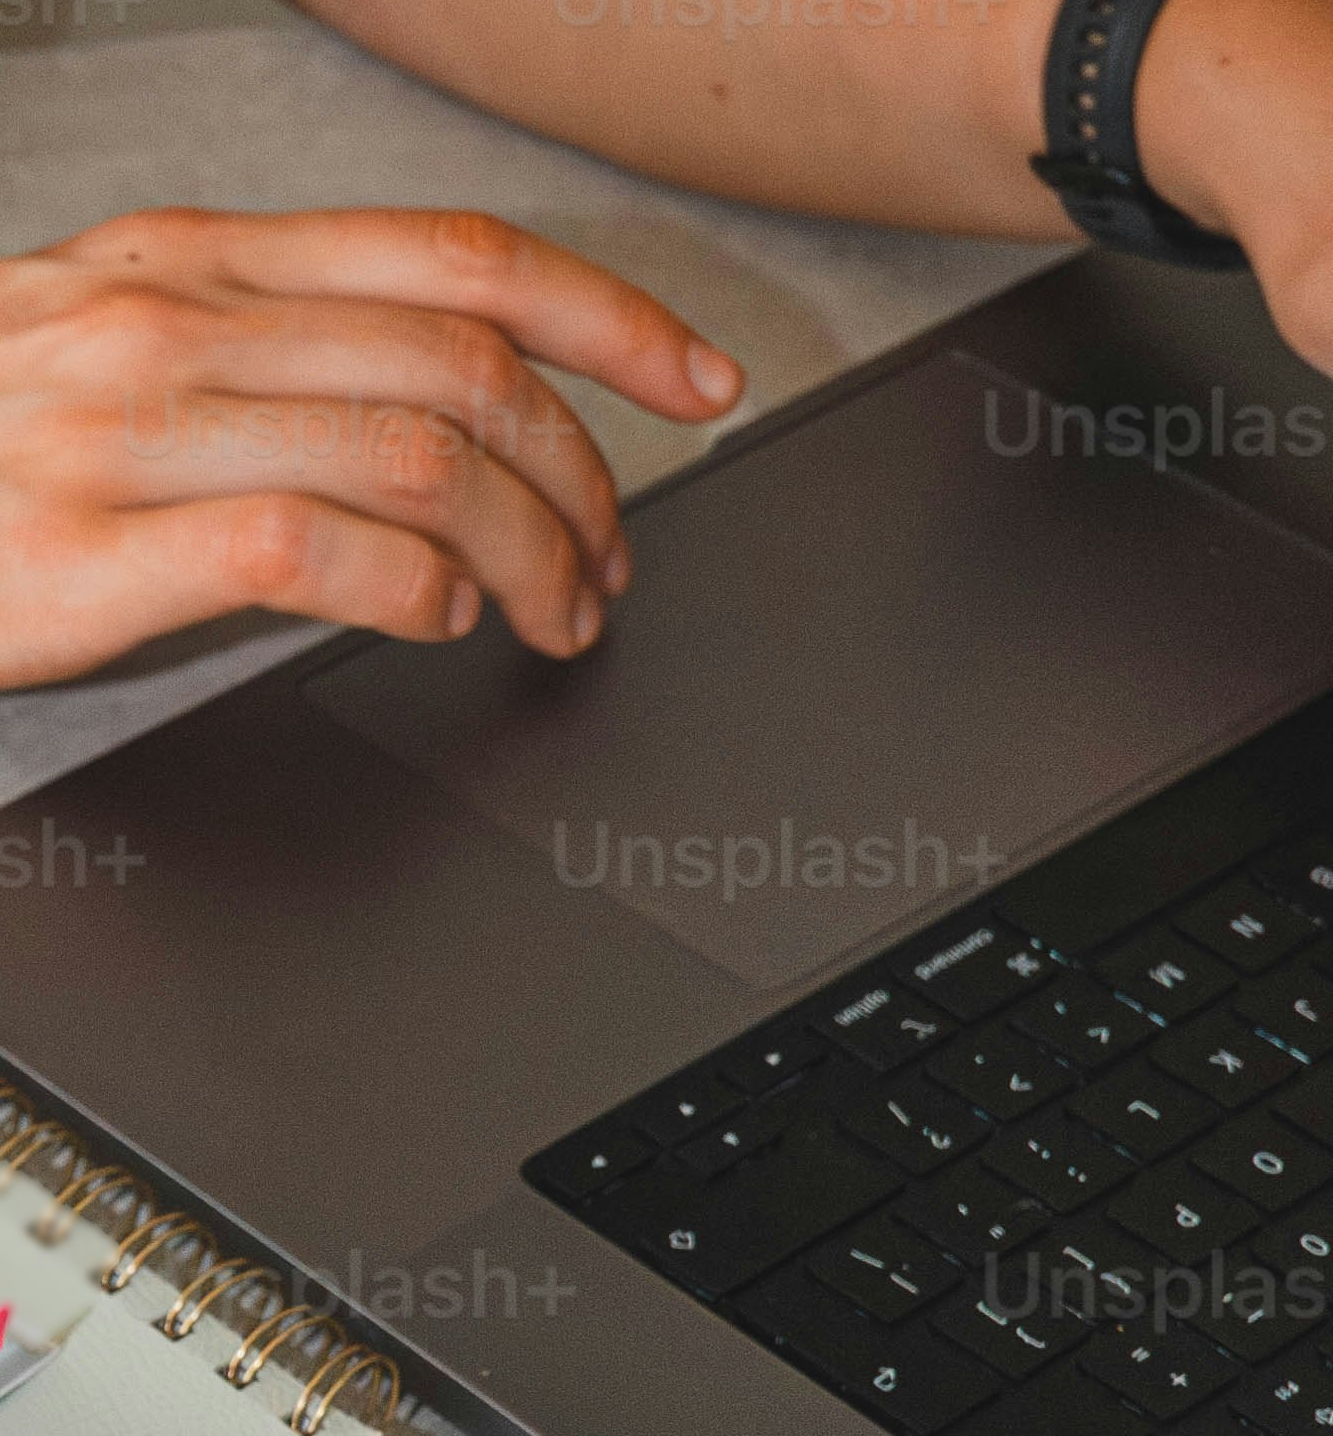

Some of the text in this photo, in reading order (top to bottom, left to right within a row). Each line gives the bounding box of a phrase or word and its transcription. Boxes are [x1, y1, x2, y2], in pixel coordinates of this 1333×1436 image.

[1231, 915, 1262, 938] N
[1151, 964, 1184, 988] M
[1209, 1051, 1241, 1073] K
[1127, 1101, 1159, 1119] L
